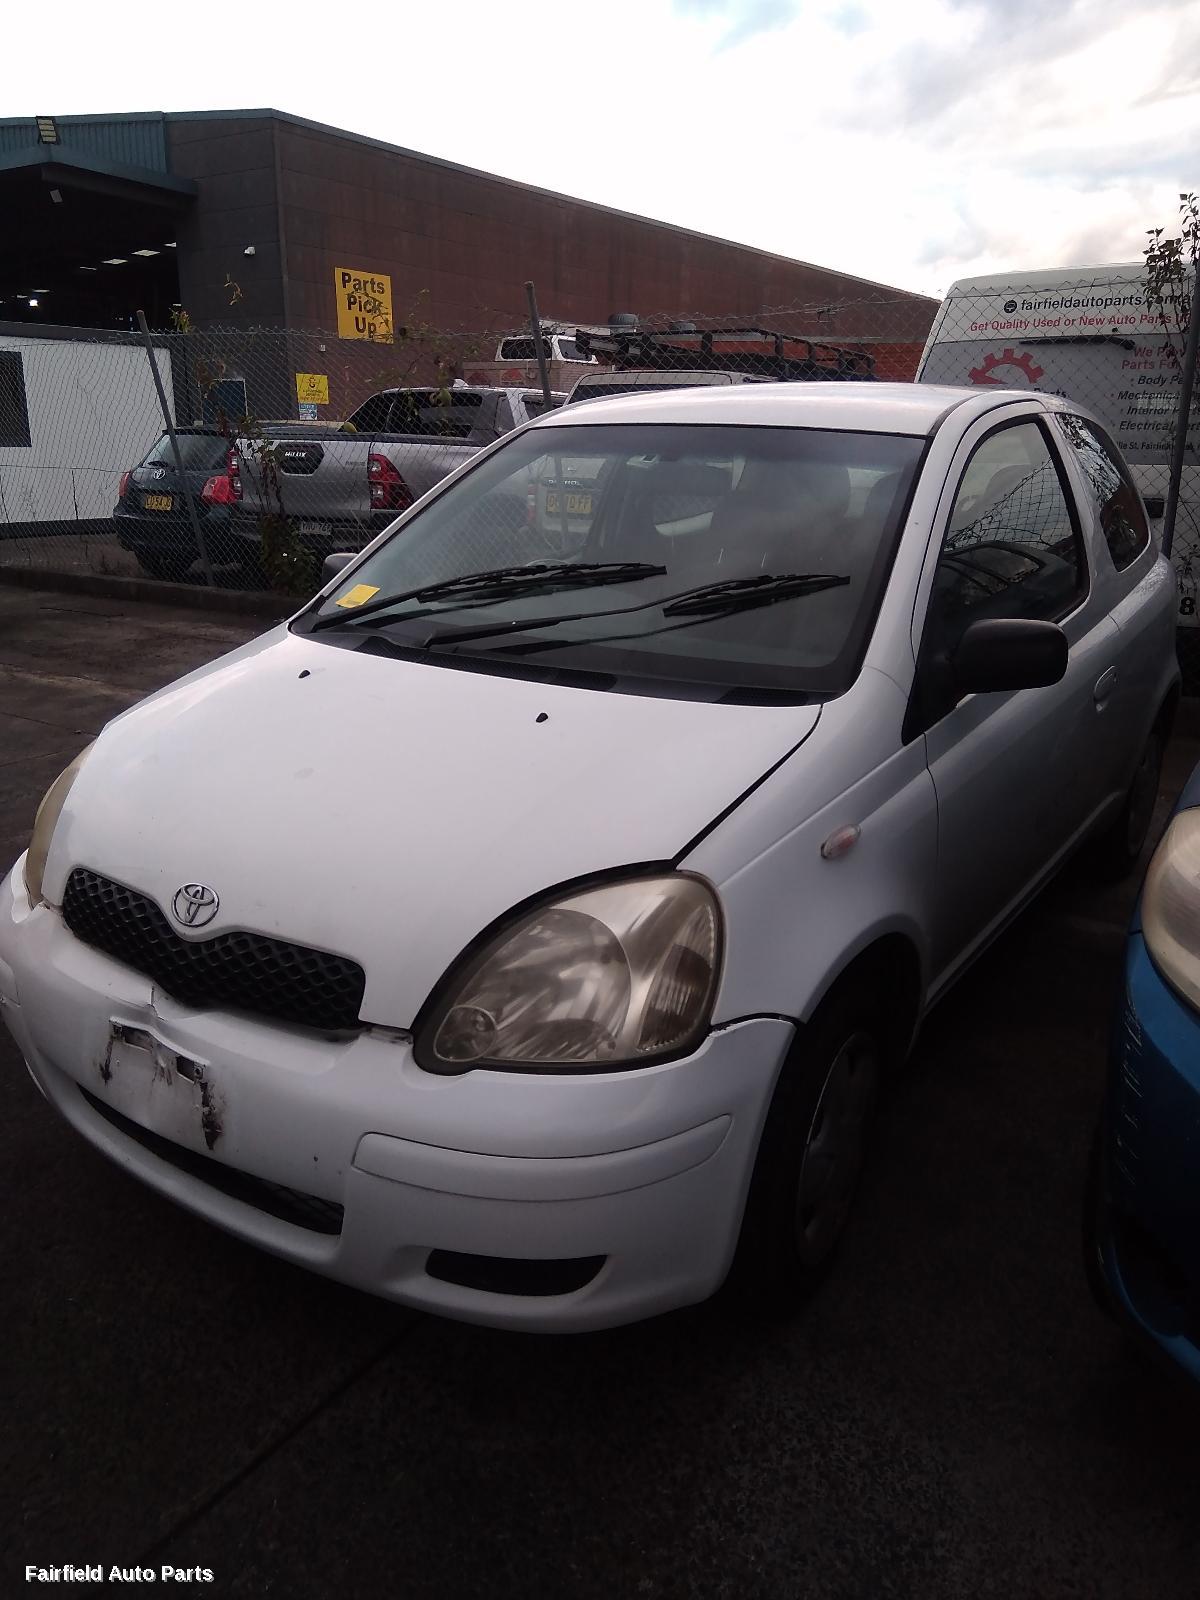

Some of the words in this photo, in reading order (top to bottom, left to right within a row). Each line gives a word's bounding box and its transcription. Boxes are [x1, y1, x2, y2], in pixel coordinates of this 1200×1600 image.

[341, 271, 385, 294] Parts
[347, 294, 382, 314] Pick
[354, 316, 377, 338] Up
[970, 322, 989, 331] Get
[991, 319, 1030, 330] Quality
[1033, 317, 1062, 328] Used
[1064, 317, 1076, 327] or
[1079, 315, 1105, 326] New
[1108, 315, 1136, 325] Auto
[1140, 314, 1172, 325] Parts
[1134, 346, 1153, 357] We
[1121, 360, 1155, 370] Parts
[1137, 374, 1167, 386] Body
[1126, 405, 1170, 416] Interior
[1119, 420, 1174, 431] Electrical
[1180, 597, 1195, 616] 8
